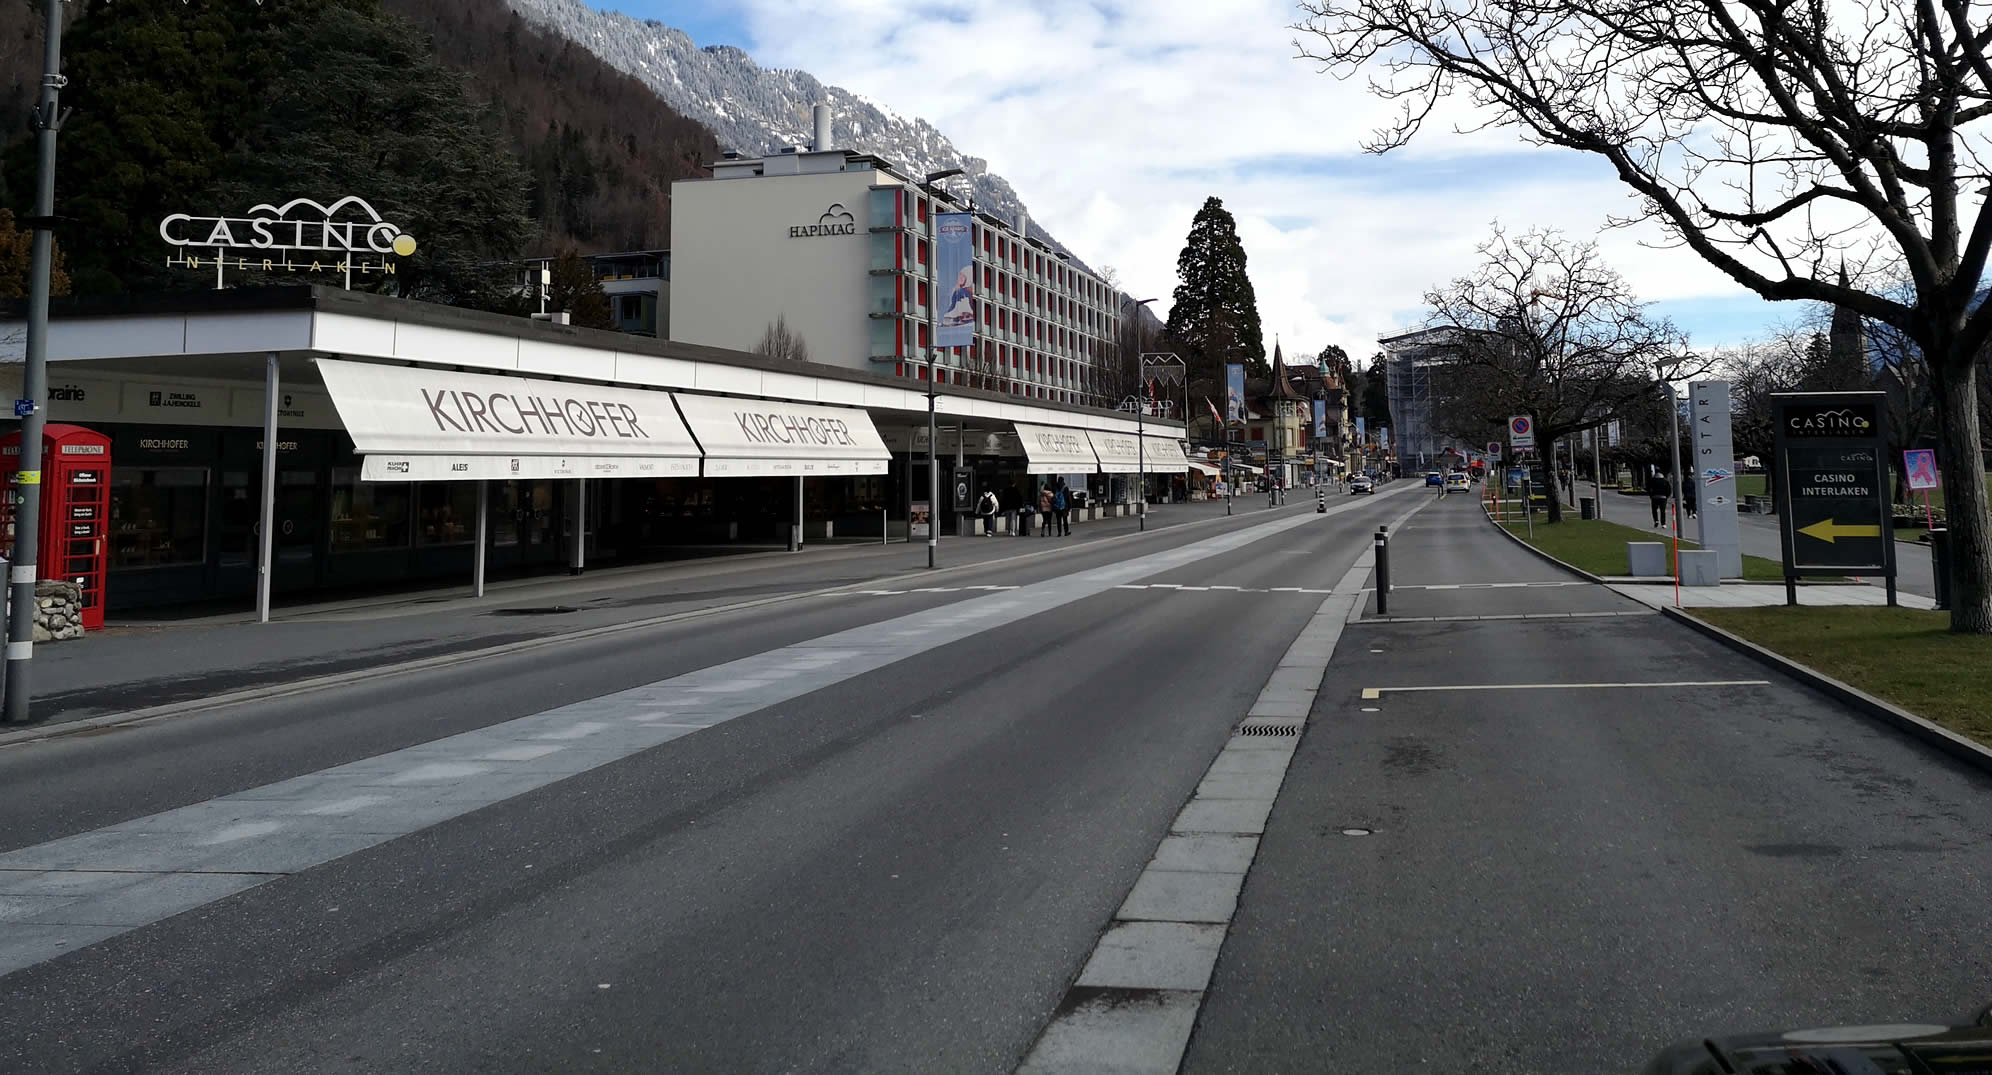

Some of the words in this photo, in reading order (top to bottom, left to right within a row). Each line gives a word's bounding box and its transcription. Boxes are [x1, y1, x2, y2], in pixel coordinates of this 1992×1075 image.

[160, 213, 401, 254] CASINO
[790, 223, 855, 238] HAPIMAG
[166, 255, 397, 275] INTERLAKEN
[421, 388, 649, 438] KIRCHHOFER
[734, 412, 857, 445] KIRCHHOFER
[1790, 417, 1867, 429] CASINO
[63, 446, 102, 454] TELEPHONE
[140, 439, 188, 449] KIRCHHOFER
[256, 441, 298, 450] KIHOFER
[1814, 474, 1855, 483] CASINO
[1802, 487, 1869, 496] INTERLAKEN
